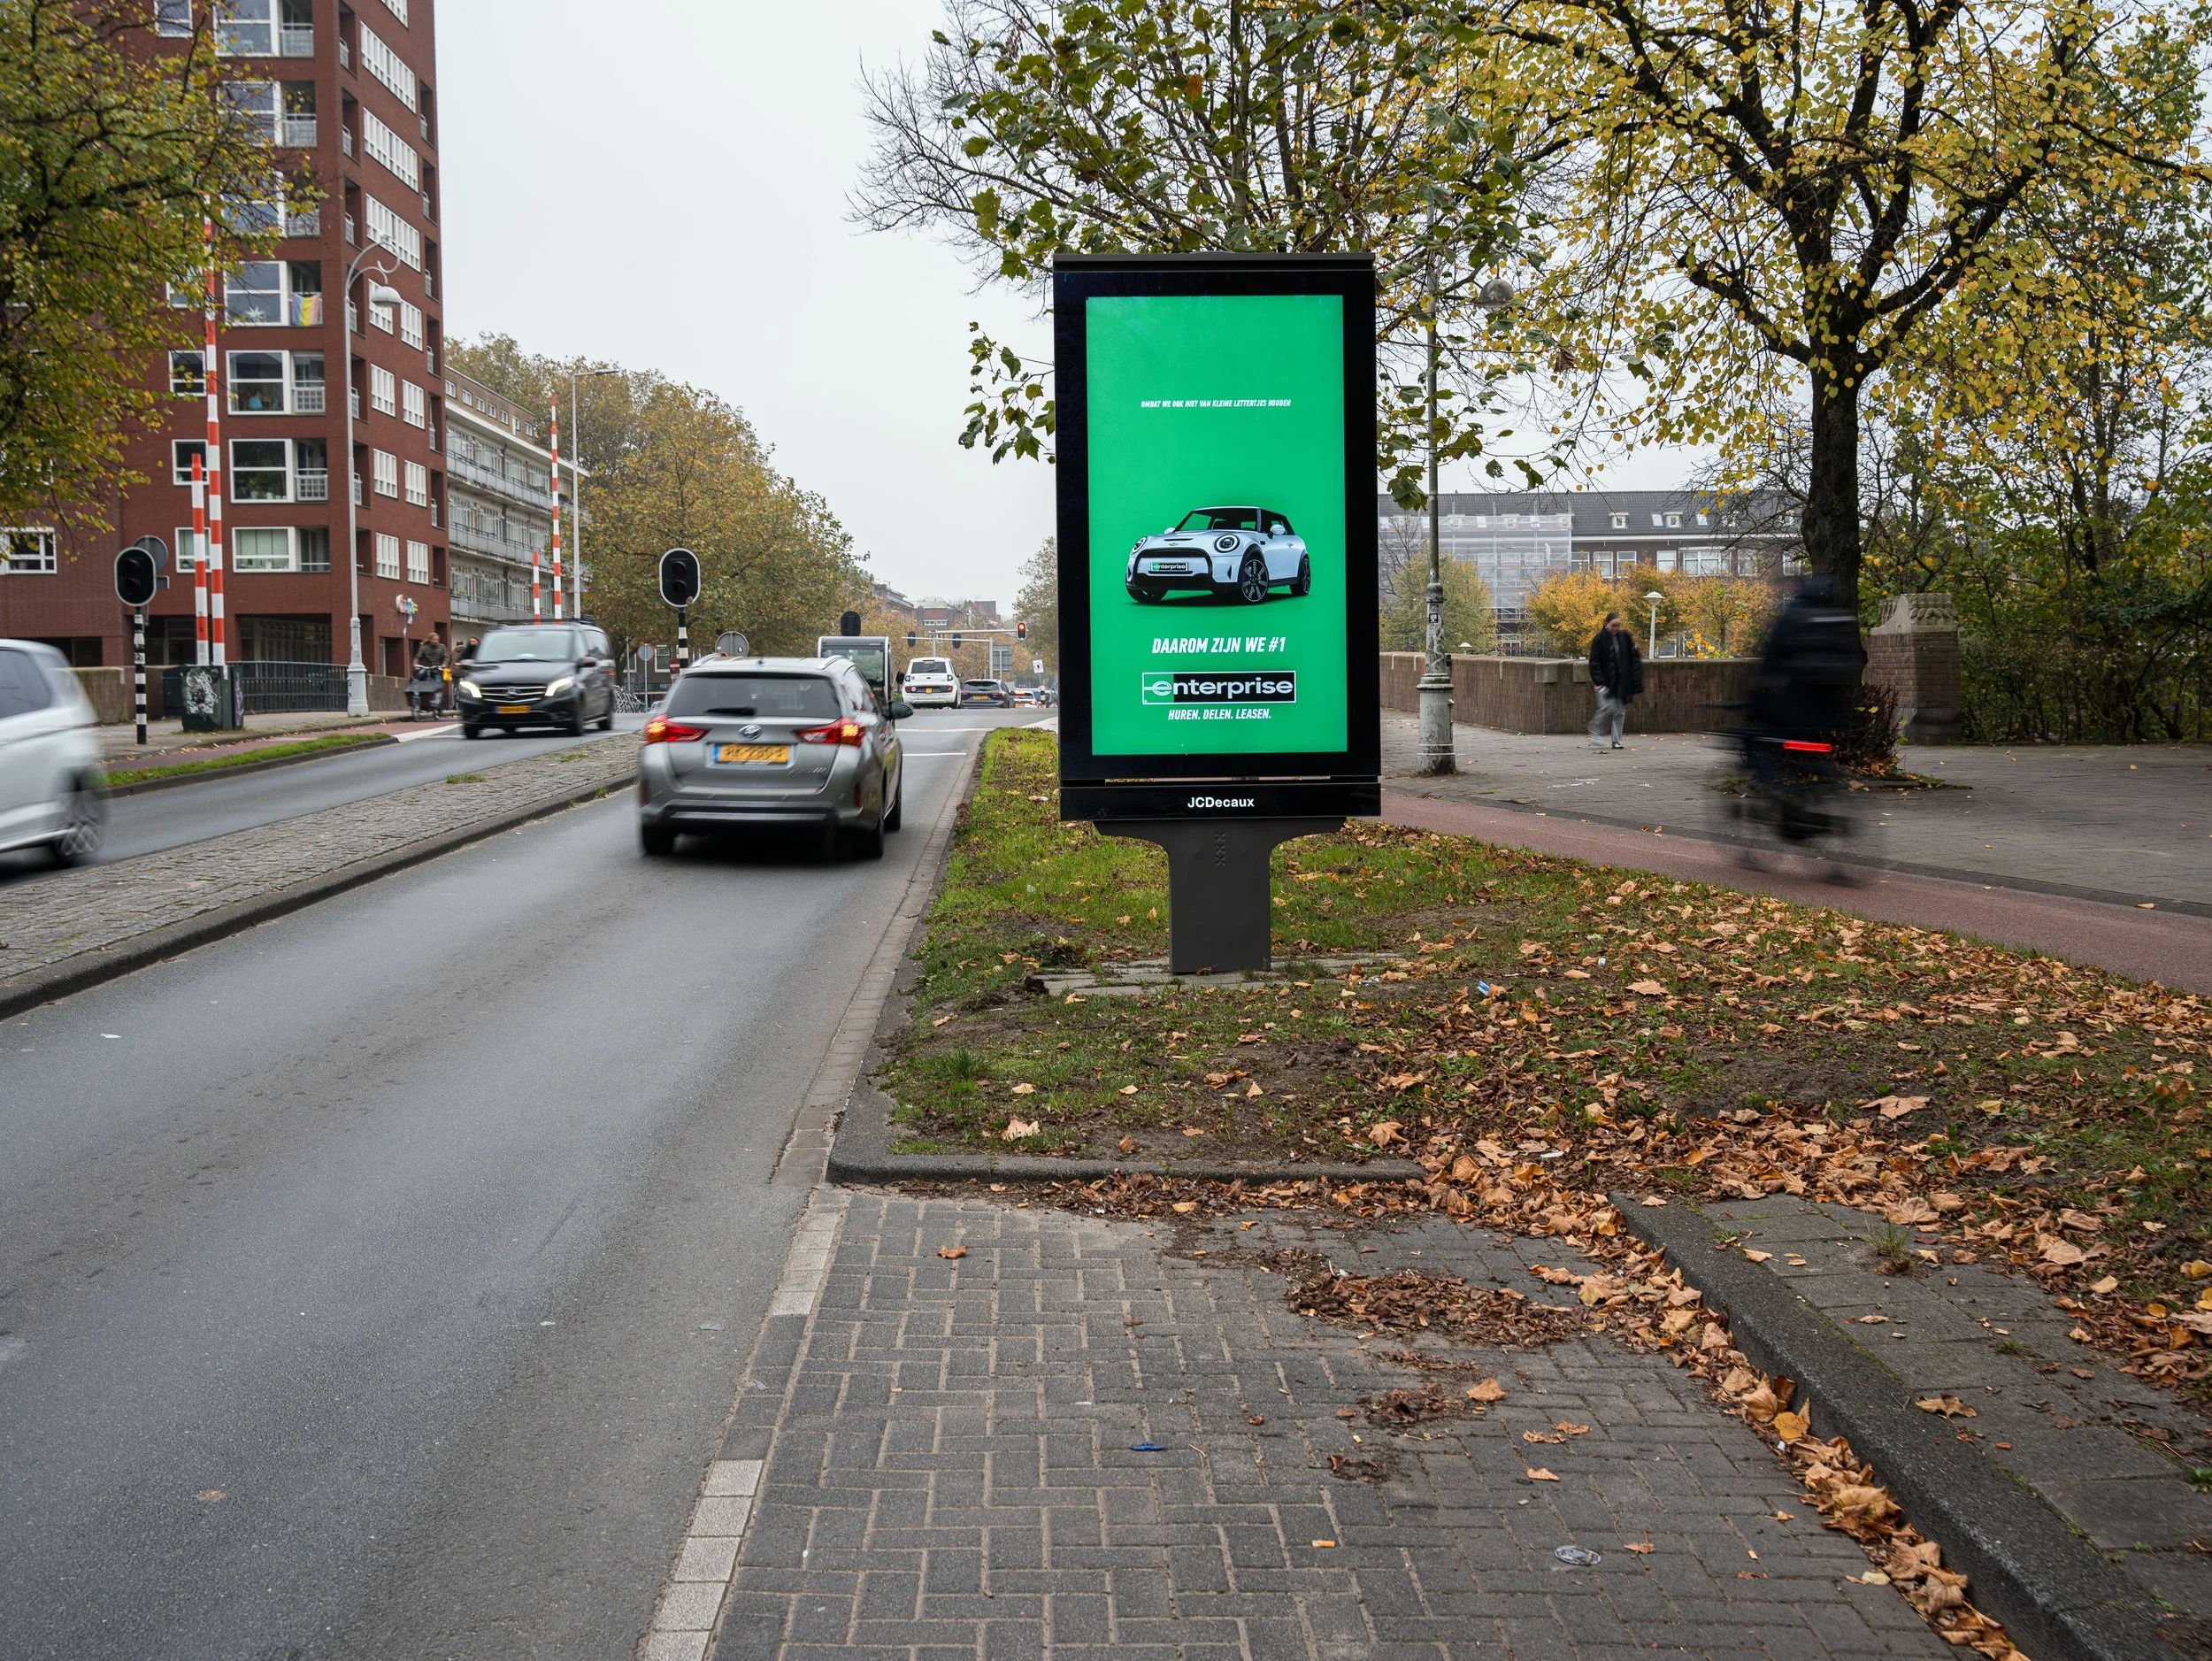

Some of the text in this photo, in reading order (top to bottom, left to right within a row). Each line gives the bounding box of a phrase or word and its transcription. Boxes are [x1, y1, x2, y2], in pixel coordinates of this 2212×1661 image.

[1152, 636, 1286, 654] DAAROM ZIJN WE #1
[1151, 676, 1294, 699] enterprise
[1167, 708, 1271, 720] HUREN. DELEN. LEASEN.
[1187, 796, 1255, 809] JCDecaux
